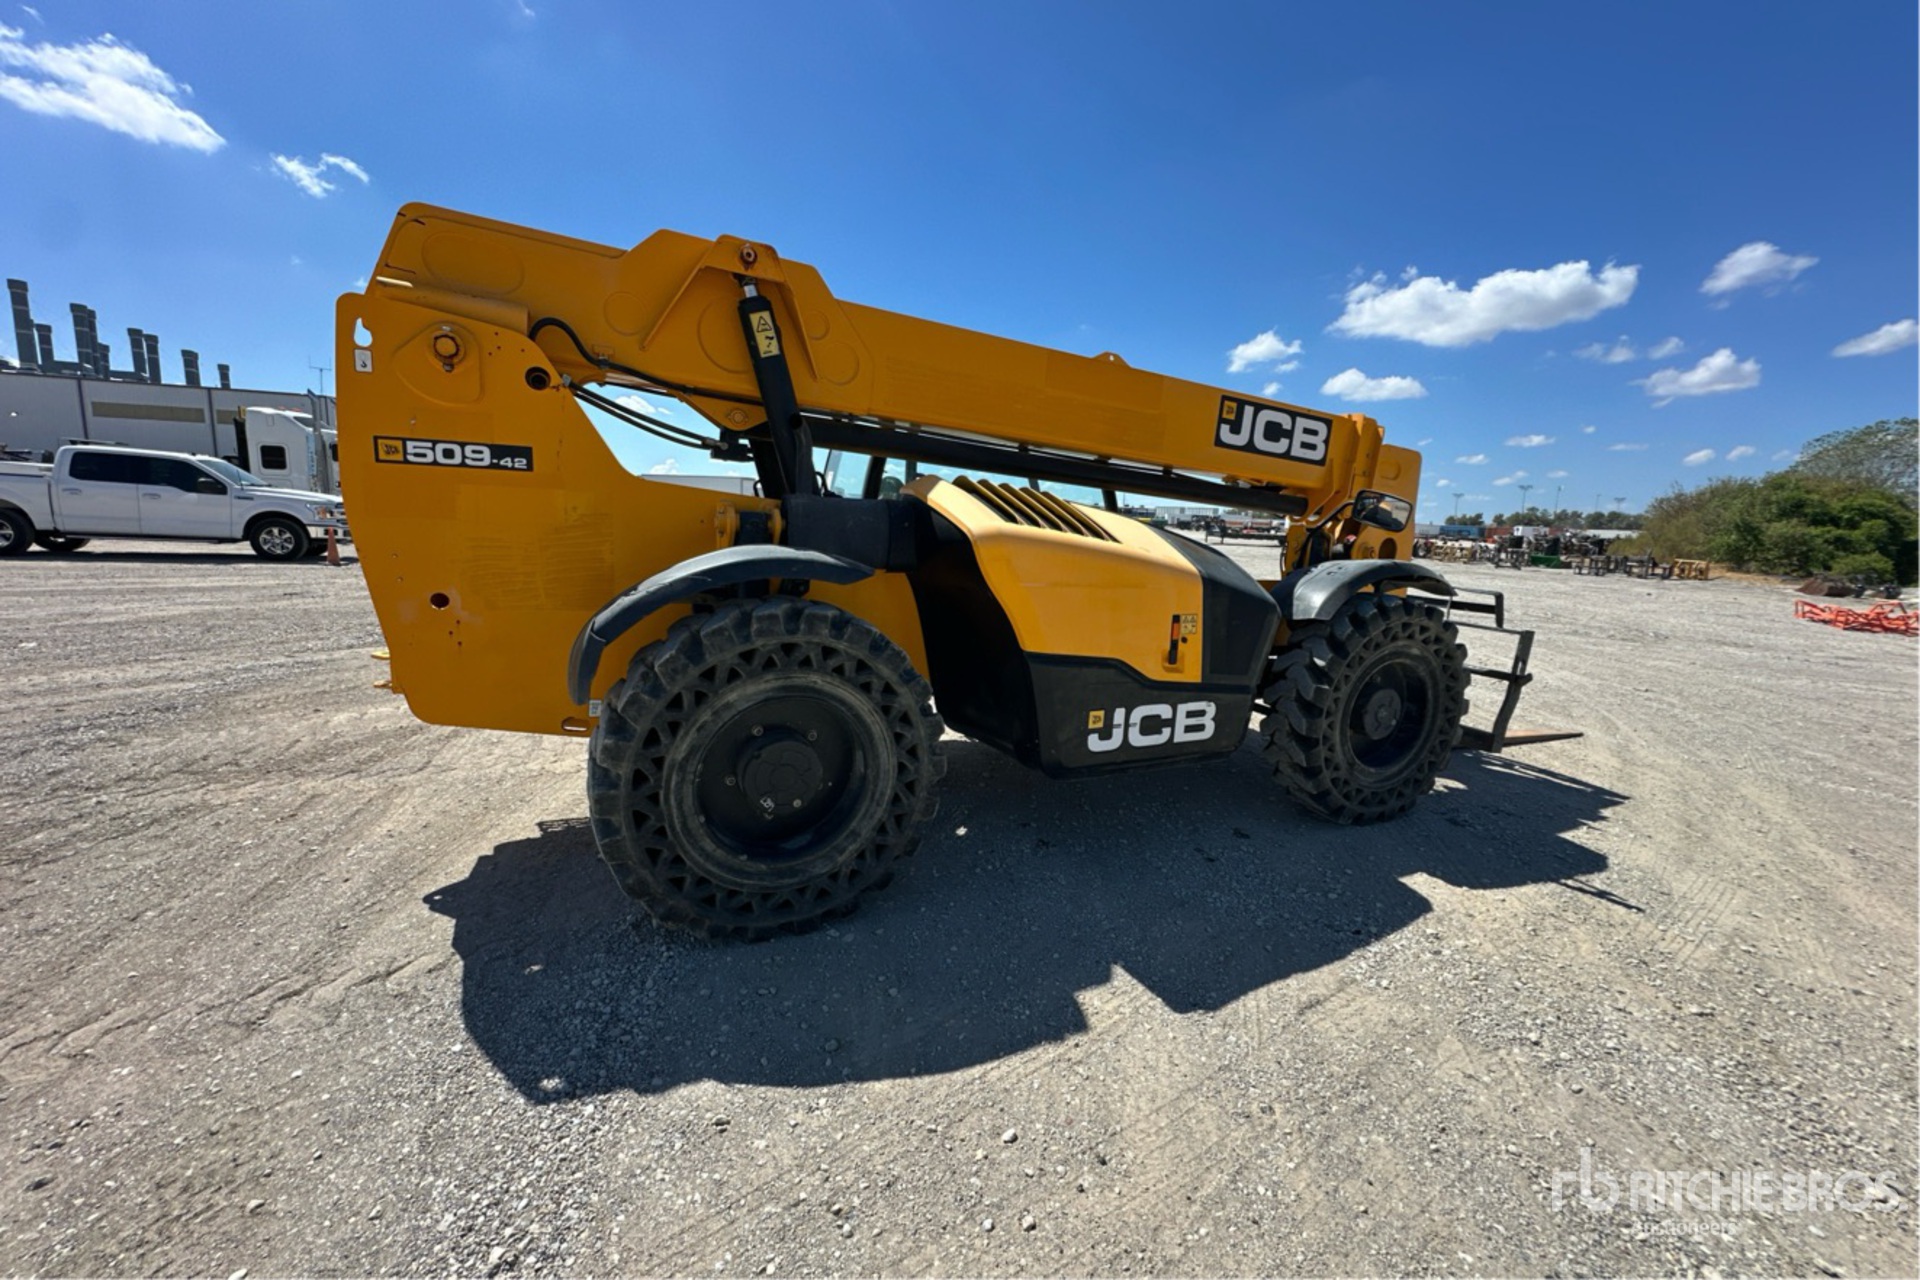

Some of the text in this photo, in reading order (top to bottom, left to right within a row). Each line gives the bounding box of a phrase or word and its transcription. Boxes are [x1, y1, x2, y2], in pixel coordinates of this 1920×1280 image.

[405, 440, 528, 469] 509-42
[1219, 404, 1328, 461] JCB
[1087, 700, 1217, 752] JCB
